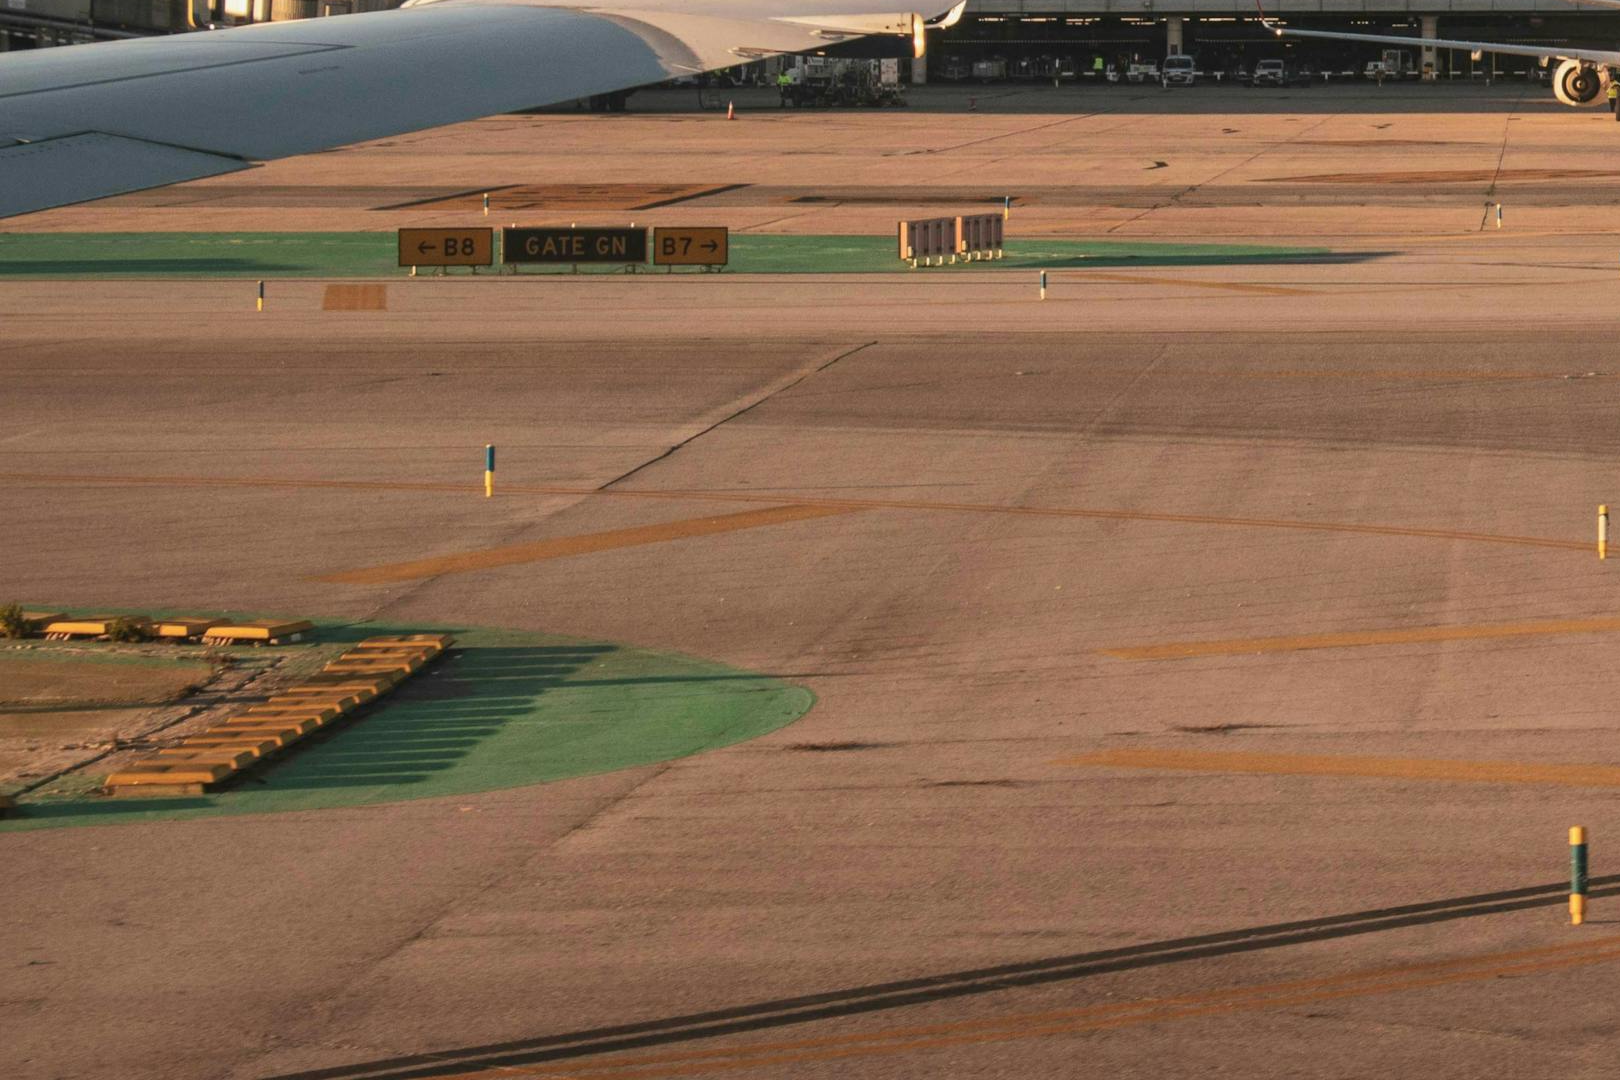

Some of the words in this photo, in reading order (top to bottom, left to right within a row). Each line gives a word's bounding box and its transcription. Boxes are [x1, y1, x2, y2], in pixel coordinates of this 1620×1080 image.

[444, 237, 475, 257] B8
[525, 236, 586, 256] GATE
[596, 236, 627, 256] GN
[662, 236, 693, 256] B7
